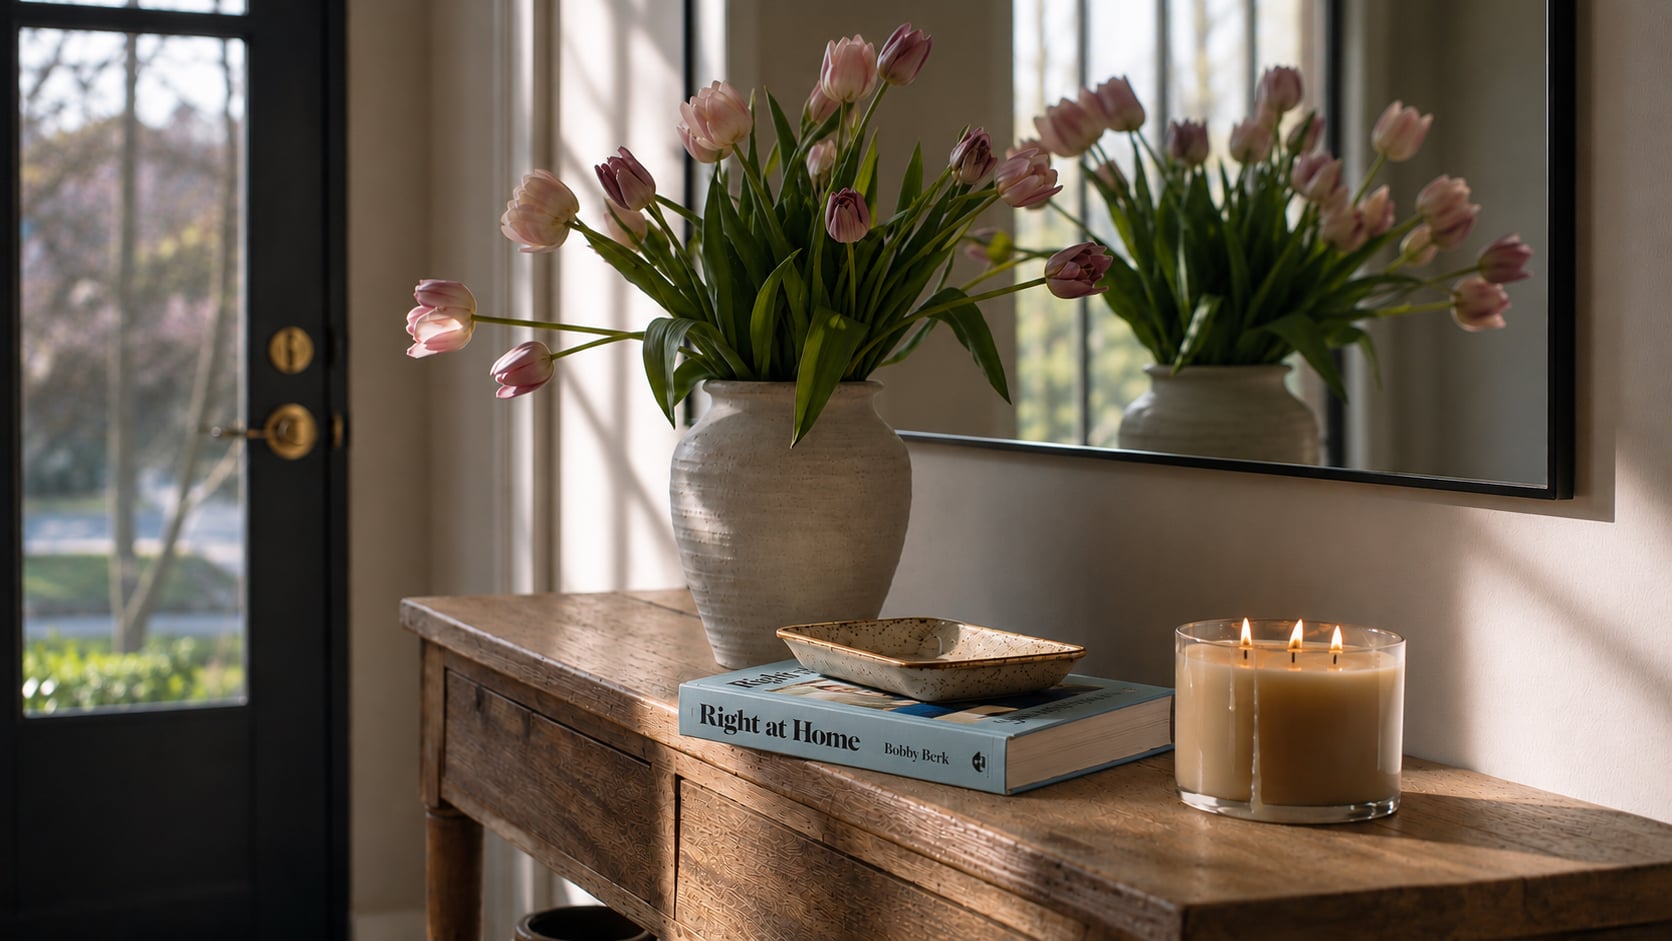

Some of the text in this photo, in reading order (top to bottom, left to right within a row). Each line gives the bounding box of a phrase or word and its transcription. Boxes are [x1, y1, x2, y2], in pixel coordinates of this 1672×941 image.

[700, 703, 861, 751] Right at Home
[884, 742, 950, 765] Bobby Berk
